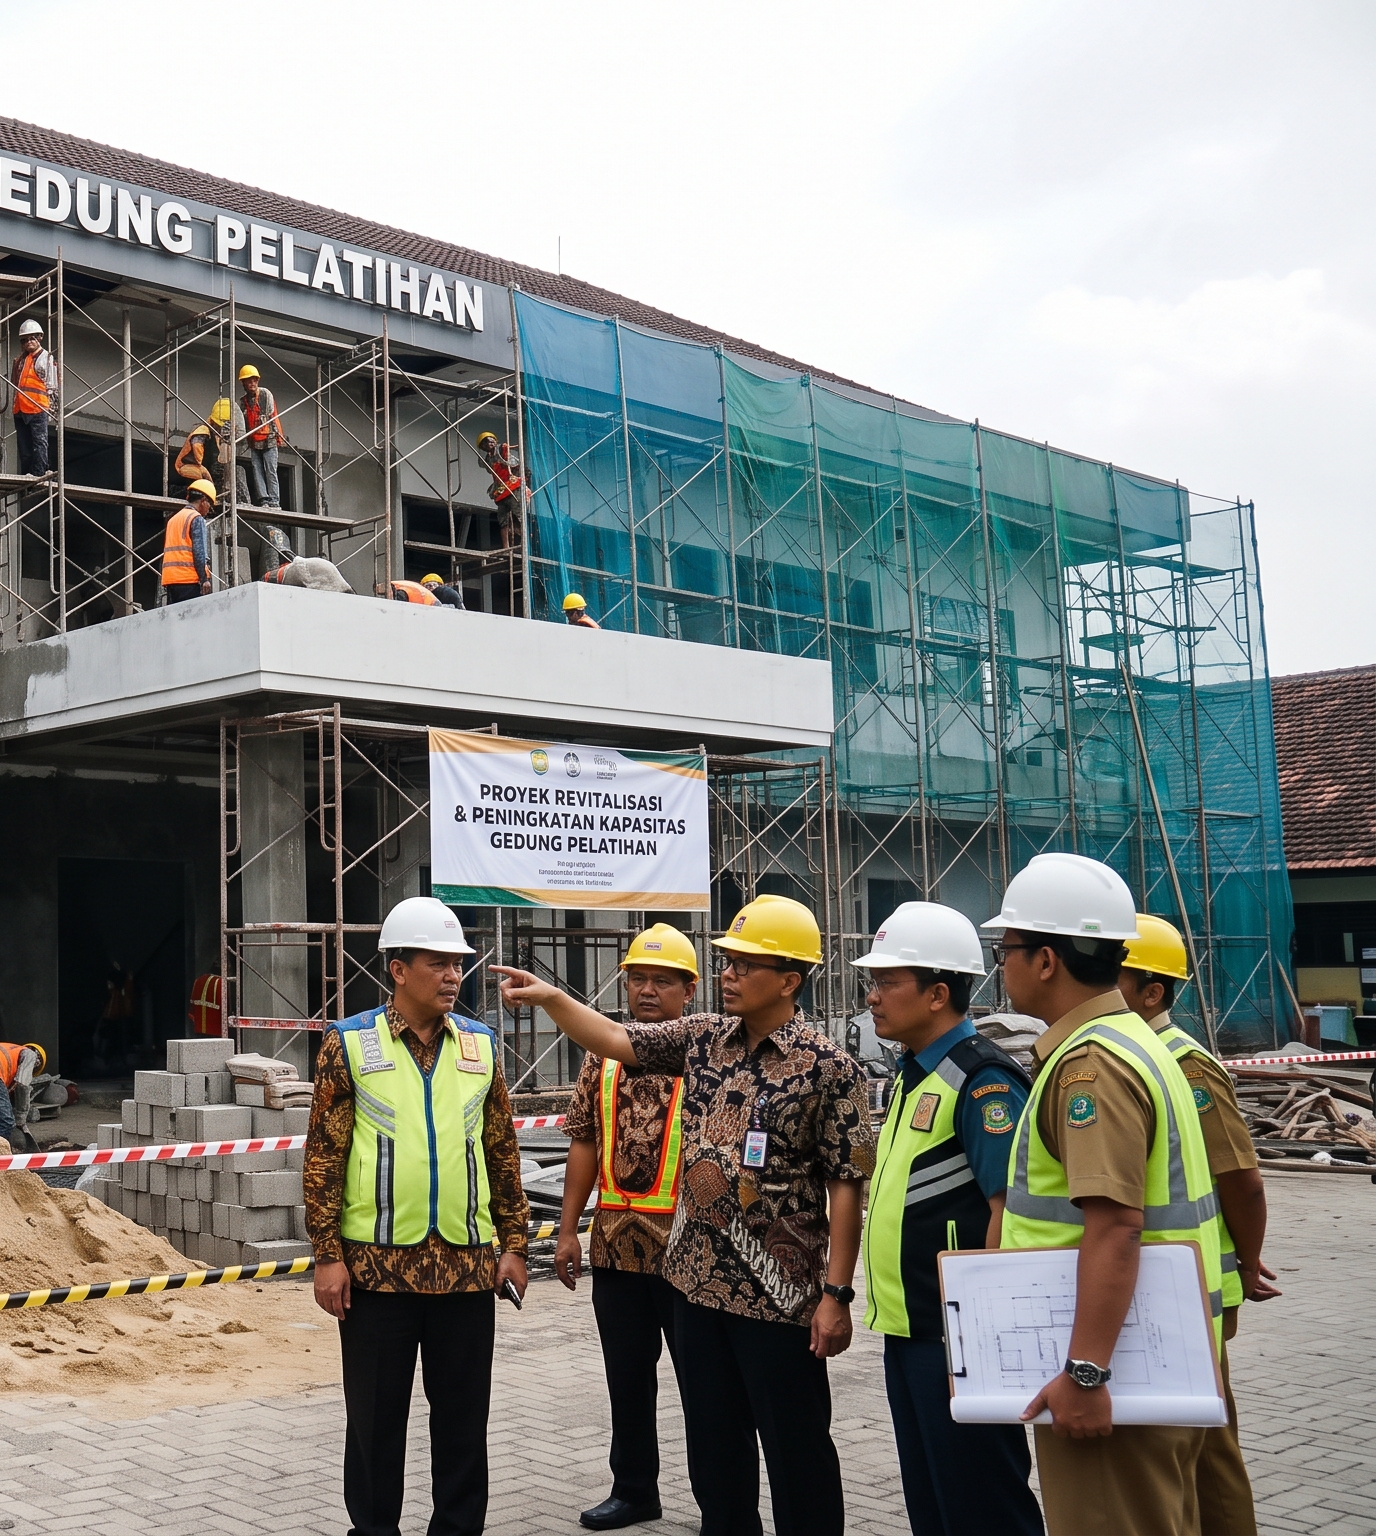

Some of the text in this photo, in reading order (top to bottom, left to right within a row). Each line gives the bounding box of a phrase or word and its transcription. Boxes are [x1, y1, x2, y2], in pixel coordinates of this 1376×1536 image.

[215, 213, 485, 333] PELATIHAN
[480, 783, 663, 812] PROYEK REVITALISASI
[454, 805, 686, 835] & PENINGKATAN KAPASITAS
[490, 831, 657, 856] GEDUNG PELATIHAN
